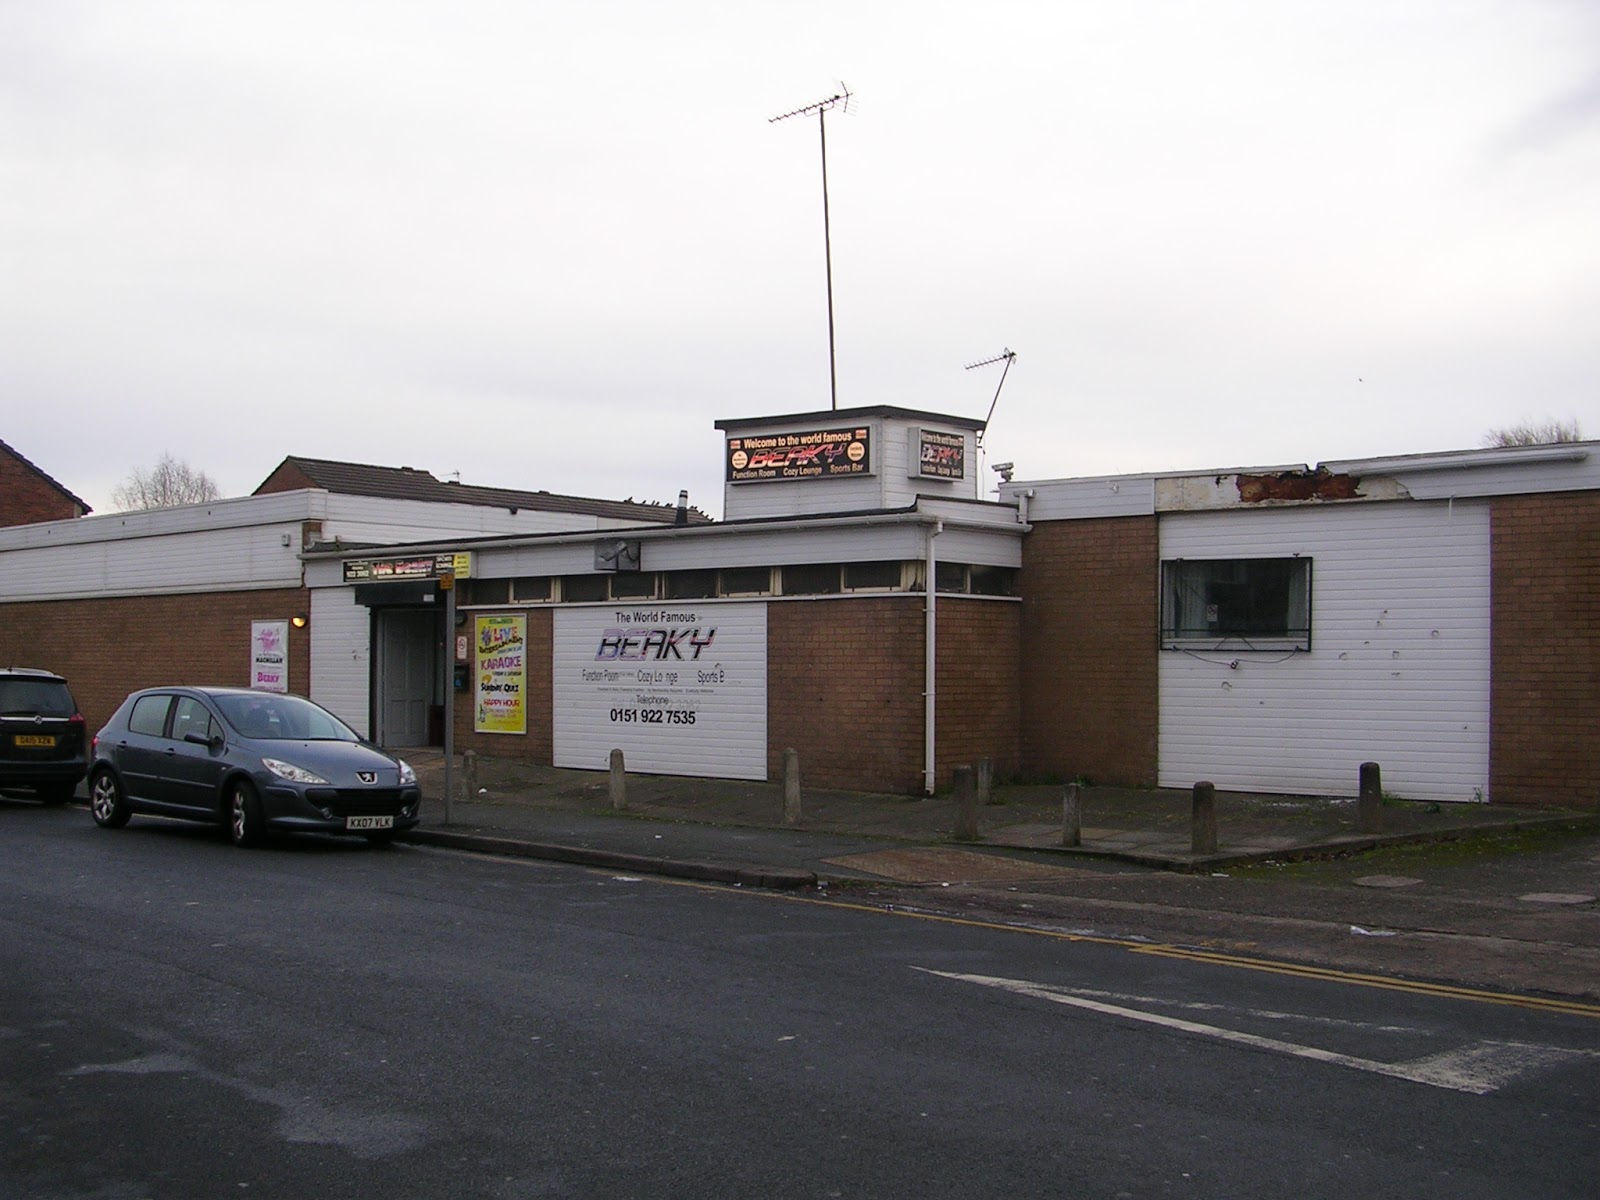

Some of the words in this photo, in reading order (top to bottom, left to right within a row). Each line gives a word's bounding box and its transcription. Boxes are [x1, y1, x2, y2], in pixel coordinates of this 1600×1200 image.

[744, 438, 777, 449] Welcome
[778, 438, 786, 446] to
[787, 436, 800, 446] the
[800, 433, 822, 444] world
[823, 432, 852, 442] famous
[748, 443, 847, 468] BEAKY
[732, 470, 758, 479] Function
[759, 469, 776, 477] Room
[783, 467, 798, 477] Cozy
[799, 465, 823, 475] Lounge
[830, 464, 851, 474] Sports
[852, 462, 864, 471] Bar
[616, 612, 631, 623] The
[633, 611, 659, 623] World
[660, 611, 696, 622] Famous
[595, 627, 718, 661] BEAKY
[480, 655, 522, 670] KARAOKE
[637, 669, 653, 685] Cozy
[698, 669, 718, 686] Sports
[483, 698, 502, 707] HAPPY
[503, 698, 520, 707] HOUR
[636, 694, 669, 706] Telephone
[610, 708, 638, 722] 0151
[641, 709, 663, 724] 922
[666, 710, 696, 725] 7535
[350, 818, 373, 828] KX07
[374, 817, 391, 827] VLK
